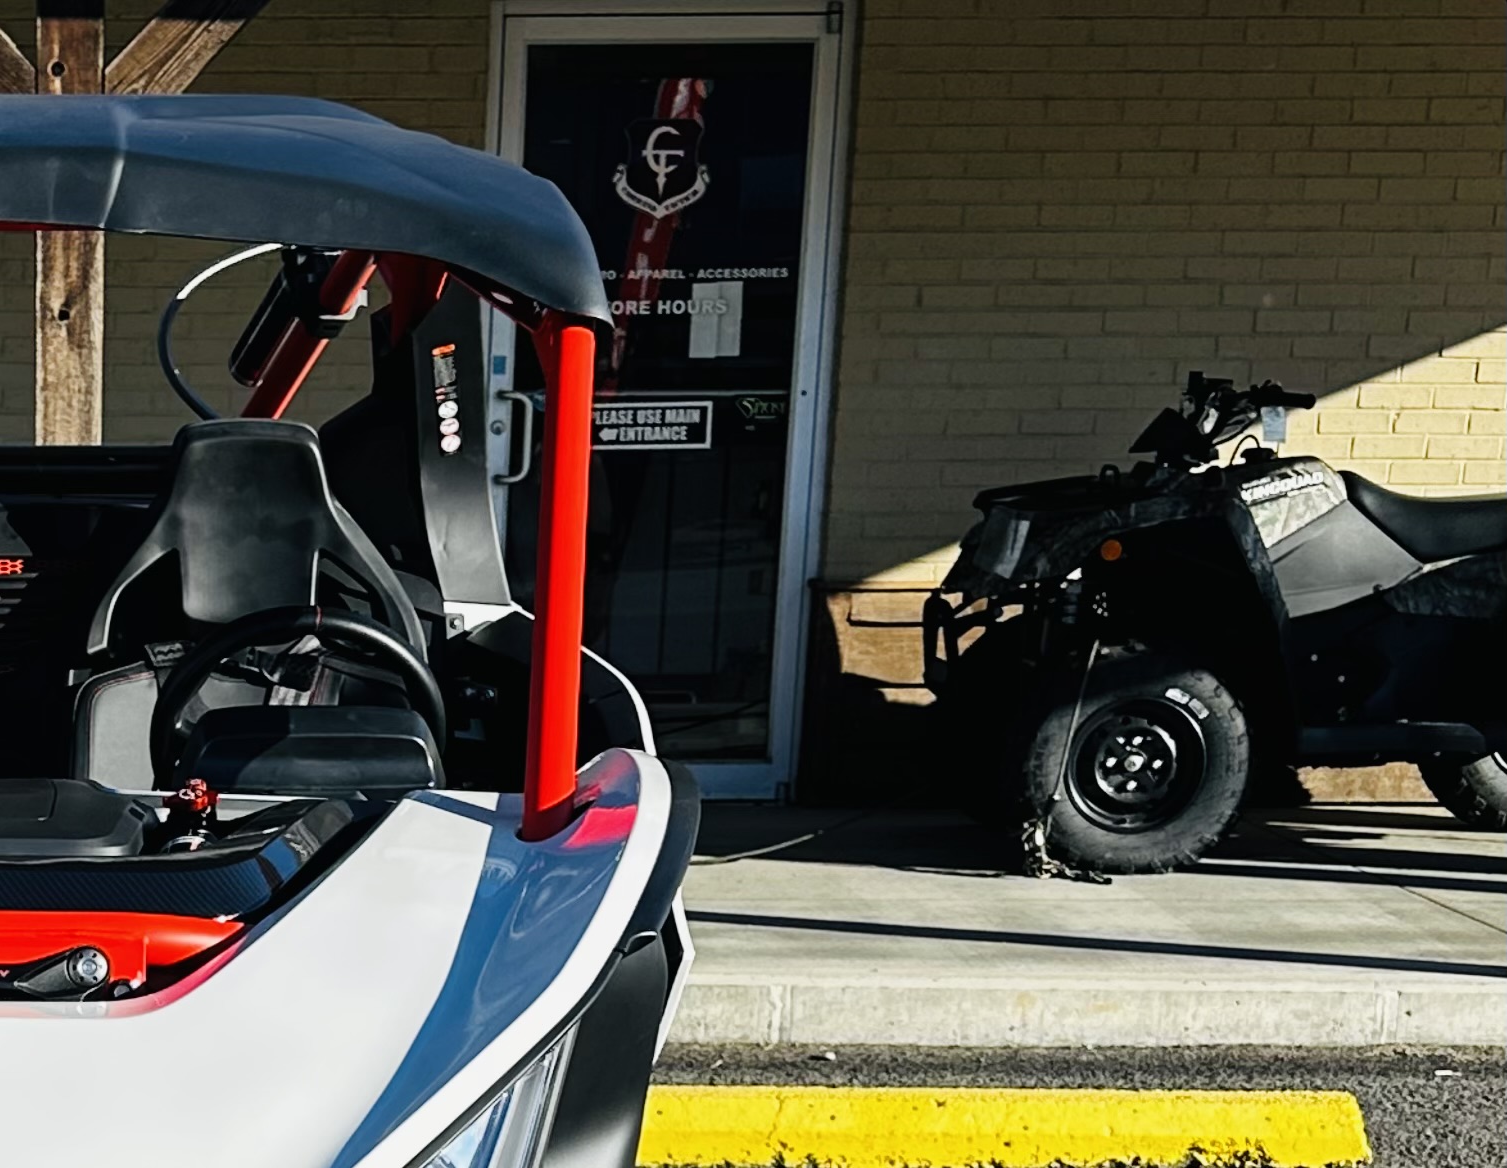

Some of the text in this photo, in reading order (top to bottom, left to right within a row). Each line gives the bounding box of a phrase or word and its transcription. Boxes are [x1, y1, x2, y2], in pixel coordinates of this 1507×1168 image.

[627, 269, 686, 280] APPAREL
[696, 267, 789, 279] ACCESSORIES
[608, 299, 728, 315] ORE HOURS
[636, 409, 663, 424] USE
[665, 408, 701, 424] MAIN
[619, 426, 688, 442] ENTRANCE
